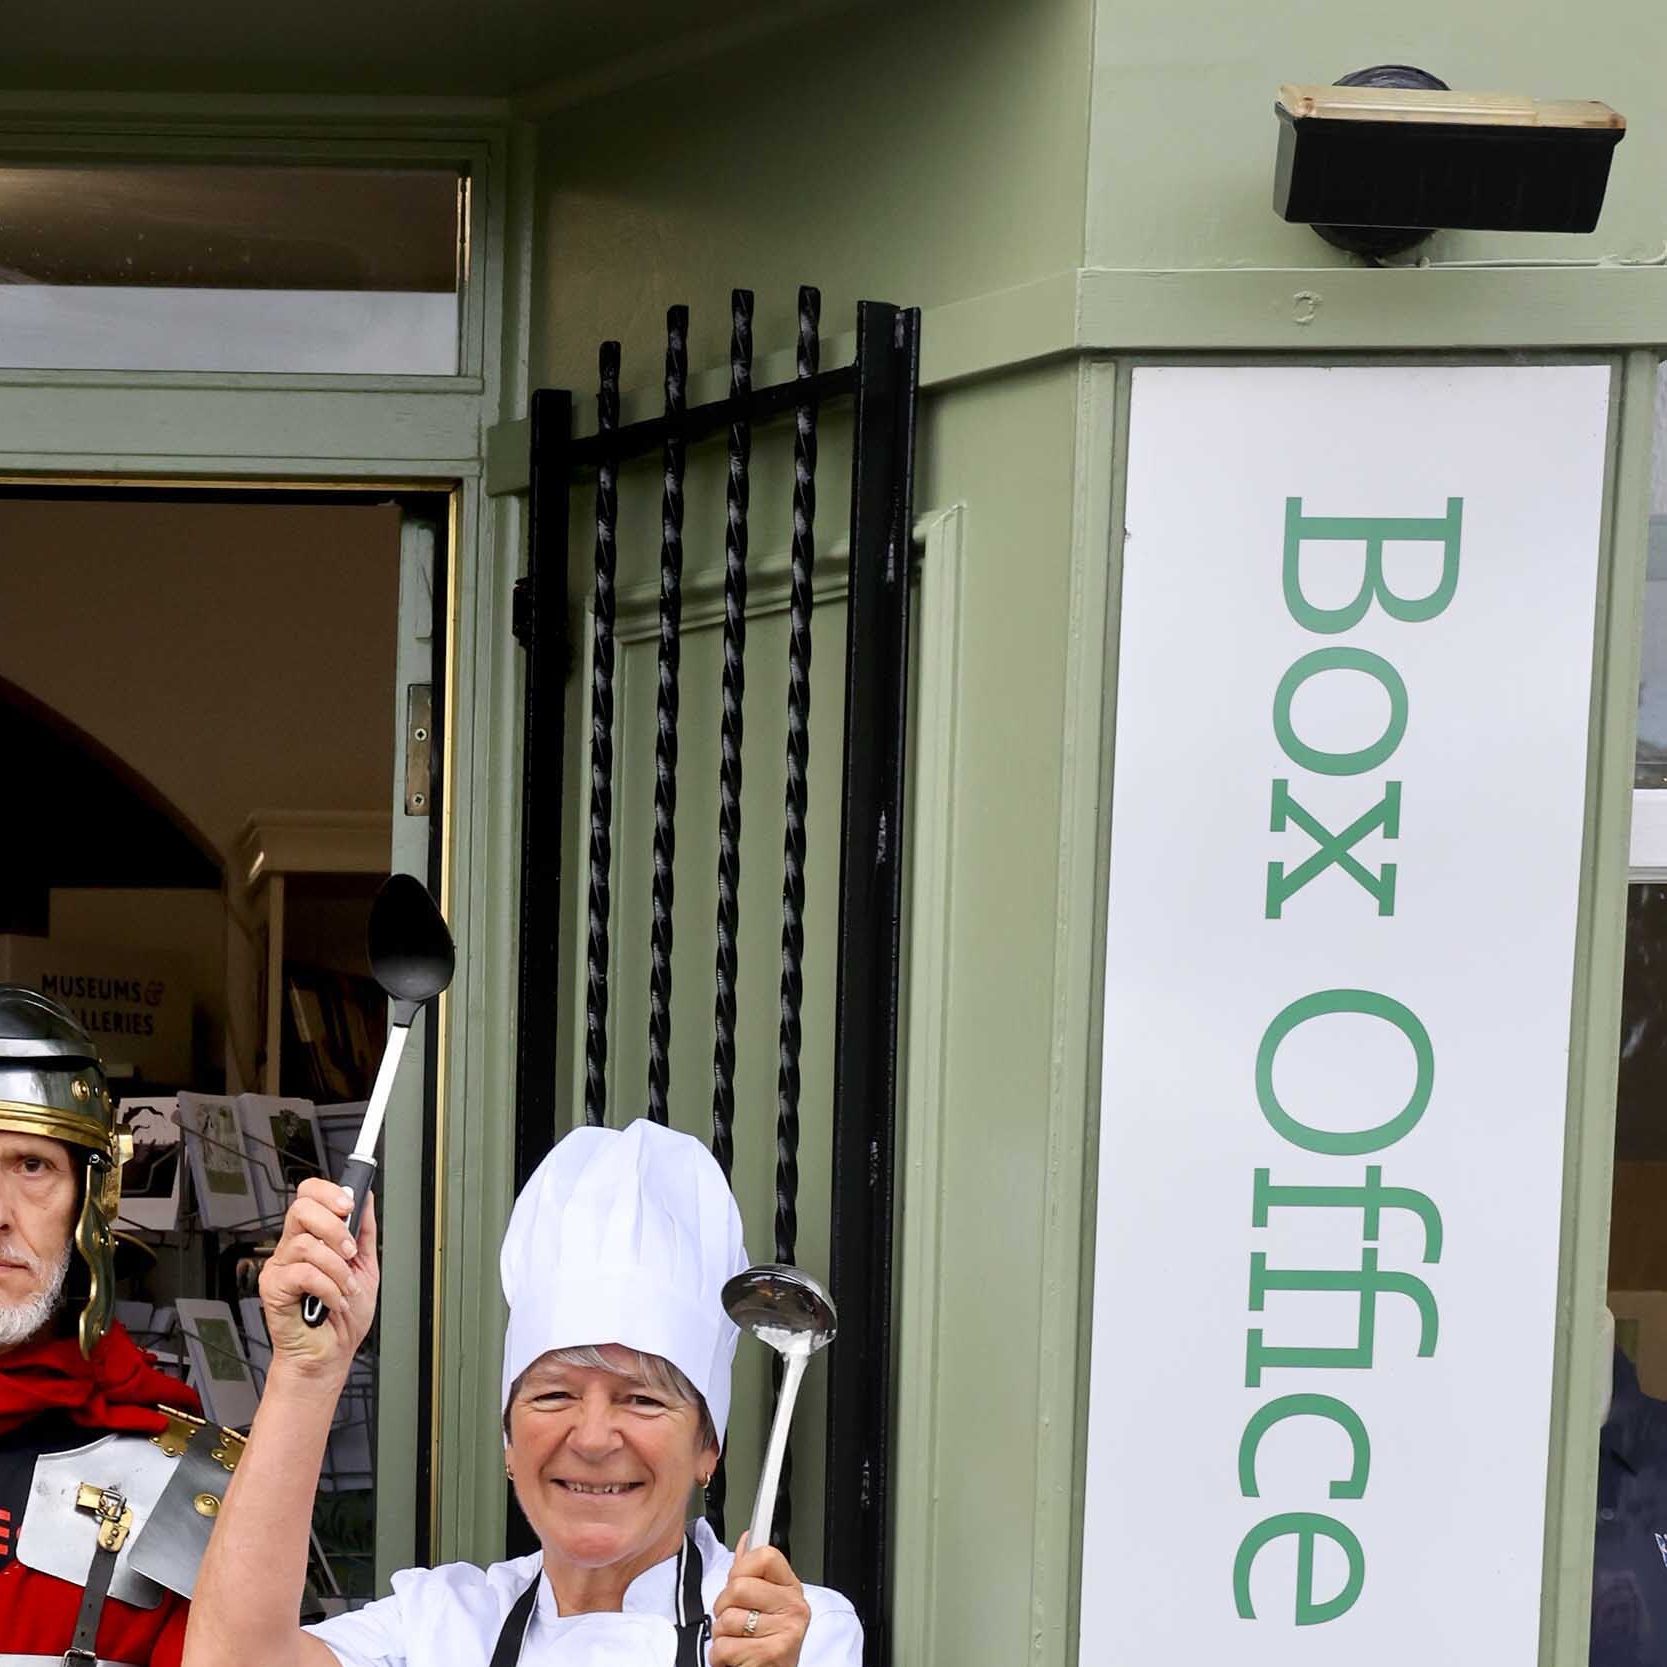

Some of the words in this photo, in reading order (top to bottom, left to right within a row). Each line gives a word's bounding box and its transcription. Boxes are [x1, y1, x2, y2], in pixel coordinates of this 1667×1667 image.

[1264, 496, 1463, 919] Box
[41, 973, 141, 1002] MUSEUMS
[1232, 988, 1443, 1627] Office
